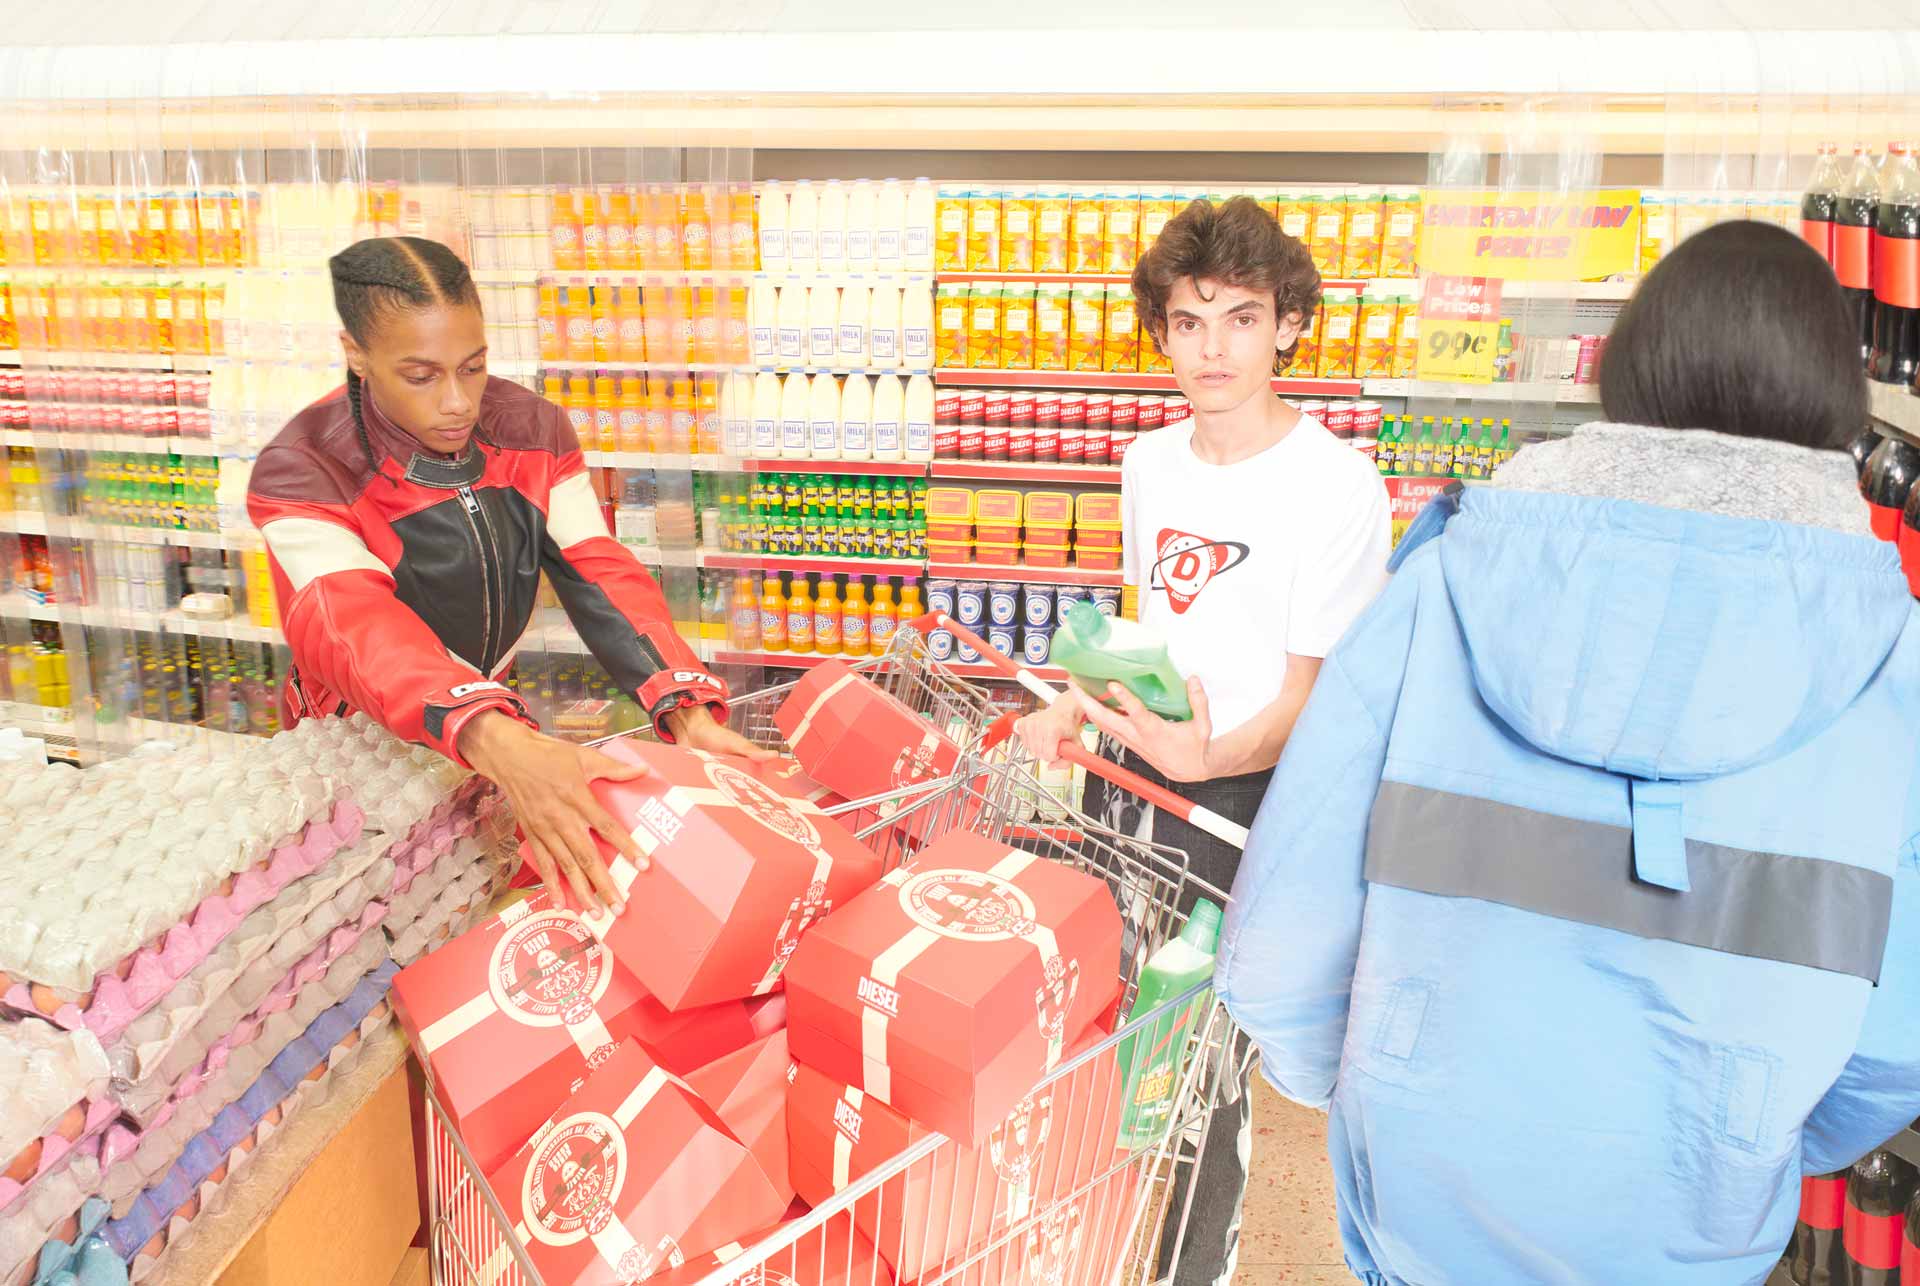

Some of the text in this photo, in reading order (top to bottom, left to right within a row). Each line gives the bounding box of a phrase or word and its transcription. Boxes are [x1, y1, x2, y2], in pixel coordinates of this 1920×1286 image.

[1567, 205, 1633, 228] LOW
[1475, 235, 1571, 257] PRICES
[1443, 283, 1482, 297] Low
[1430, 300, 1492, 315] Prices
[781, 334, 798, 343] MILK
[813, 333, 830, 342] MILK
[842, 330, 859, 340] MILK
[874, 335, 891, 344] MILK
[907, 334, 924, 343] MILK
[936, 401, 960, 413] DIESEL
[960, 402, 983, 413] DIESEL
[986, 403, 1009, 414] DIESEL
[1010, 404, 1033, 415] DIESEL
[1036, 404, 1060, 415] DIESEL
[1060, 405, 1083, 416] DIESEL
[1086, 406, 1110, 417] DIESEL
[1112, 407, 1136, 418] DIESEL
[1139, 407, 1163, 418] DIESEL
[1164, 408, 1188, 420] DIESEL
[785, 425, 802, 434] MILK
[815, 426, 832, 436] MILK
[847, 427, 864, 436] MILK
[877, 428, 895, 437] MILK
[910, 428, 928, 437] MILK
[935, 436, 958, 447] DIESEL
[960, 437, 982, 448] DIESEL
[984, 437, 1007, 448] DIESEL
[1010, 439, 1033, 450] DIESEL
[1034, 439, 1057, 450] DIESEL
[1084, 441, 1107, 451] DIESEL
[1171, 551, 1201, 582] D
[640, 796, 684, 843] DIESEL
[858, 977, 901, 1012] DIESEL
[834, 1097, 864, 1139] DIESEL
